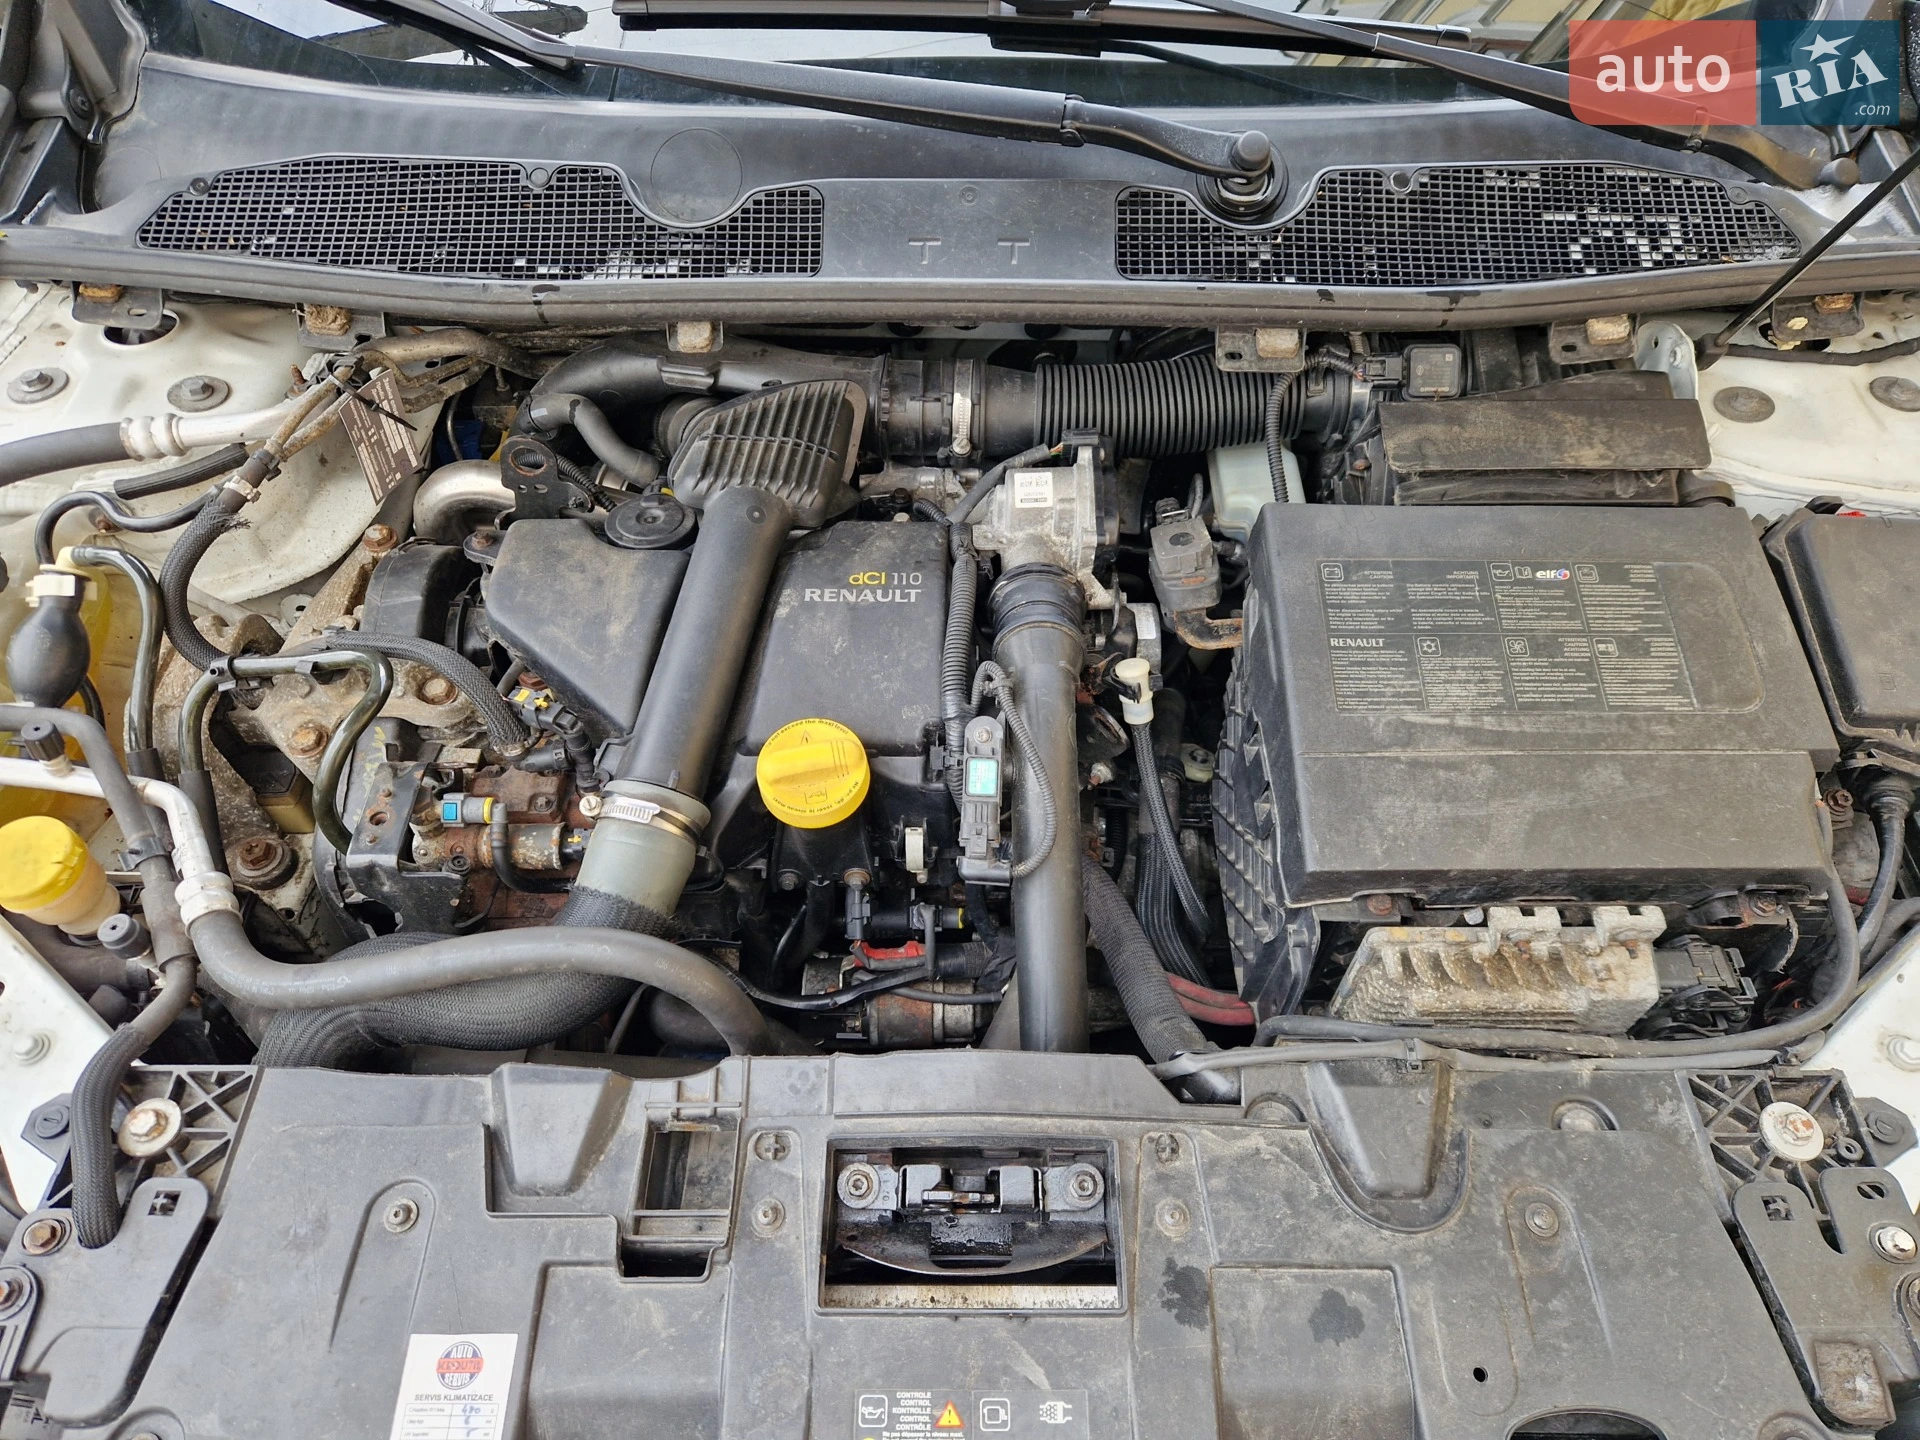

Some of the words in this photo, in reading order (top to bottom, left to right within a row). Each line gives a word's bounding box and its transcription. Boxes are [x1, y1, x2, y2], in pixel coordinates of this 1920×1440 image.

[891, 572, 922, 585] 110
[1536, 569, 1557, 579] elf
[804, 588, 922, 603] RENAULT
[1330, 638, 1385, 647] RENAULT
[780, 720, 804, 733] exceed
[450, 1345, 473, 1358] AUTO
[444, 1373, 471, 1386] SERVIS
[896, 1391, 931, 1399] CONTROLE
[900, 1399, 931, 1407] CONTROL
[899, 1415, 931, 1423] CONTROL
